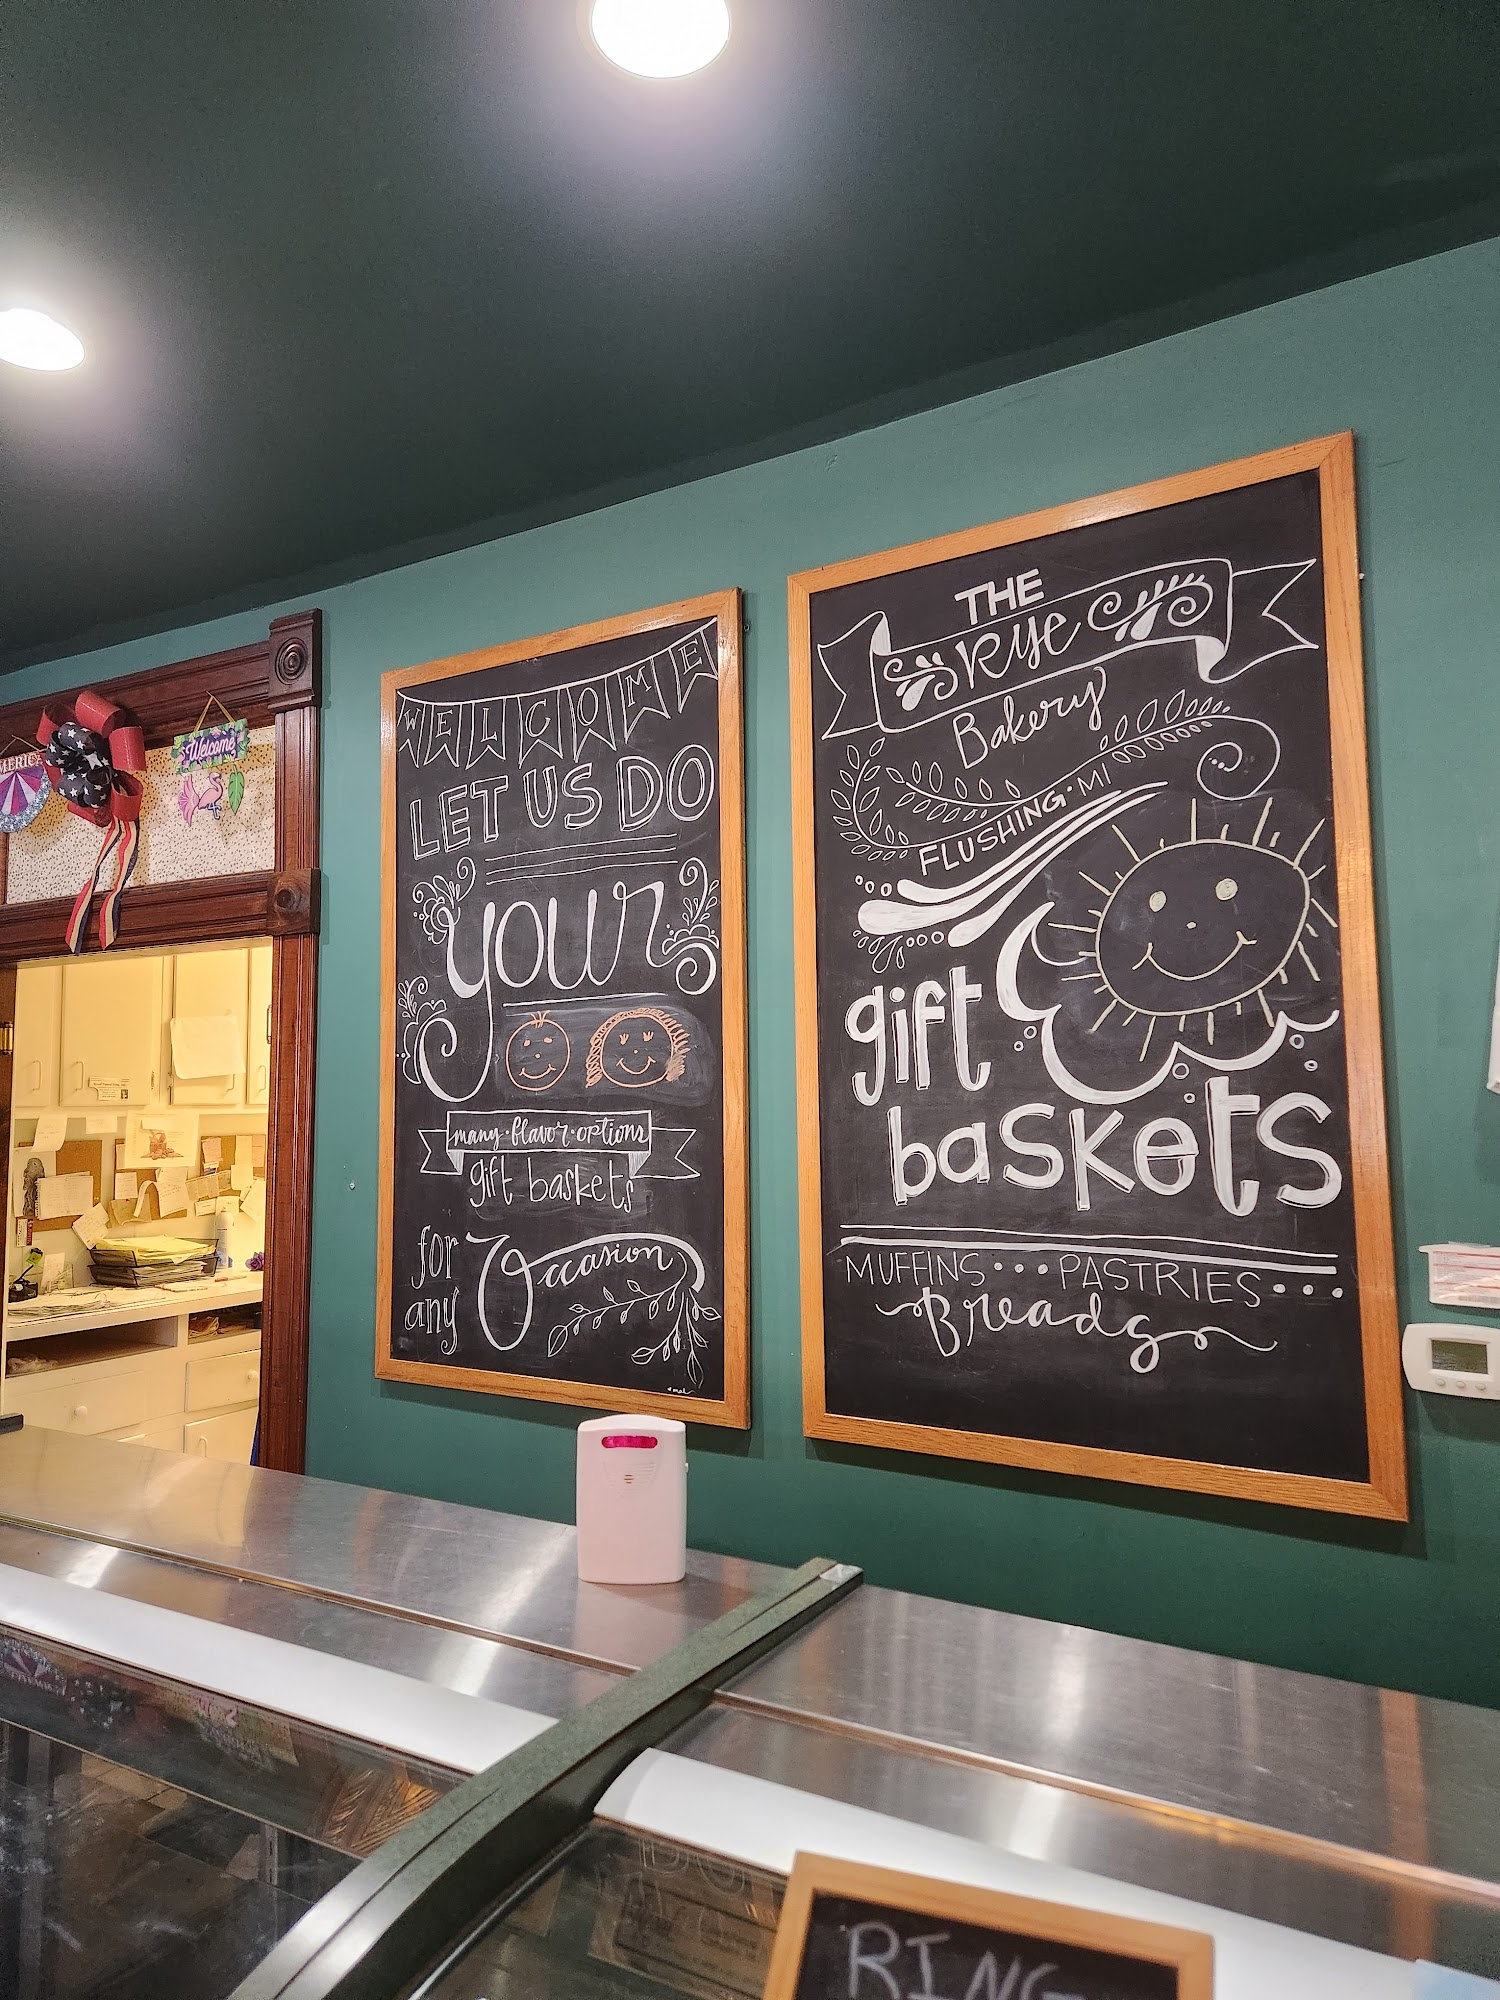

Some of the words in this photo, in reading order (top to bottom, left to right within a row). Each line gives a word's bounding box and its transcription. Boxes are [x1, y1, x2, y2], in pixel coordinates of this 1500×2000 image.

[954, 568, 1045, 626] THE
[403, 637, 703, 743] WELCOME
[952, 666, 1107, 770] Bakery
[185, 736, 236, 761] Welcome
[409, 775, 509, 861] LET
[523, 762, 603, 830] US
[615, 744, 716, 832] DO
[918, 790, 1067, 876] FLUSHING
[1077, 762, 1111, 797] MI
[844, 965, 992, 1107] gift
[449, 1126, 504, 1151] many
[511, 1116, 570, 1148] flavor
[576, 1117, 650, 1147] options
[887, 1075, 1343, 1217] baskets
[469, 1155, 513, 1208] gift
[527, 1157, 634, 1213] baskets
[410, 1225, 460, 1289] for
[465, 1231, 706, 1351] Occasion
[845, 1252, 987, 1288] MUFFINS
[1058, 1253, 1262, 1308] PASTRIES
[404, 1286, 460, 1356] any
[876, 1286, 1277, 1374] Breads
